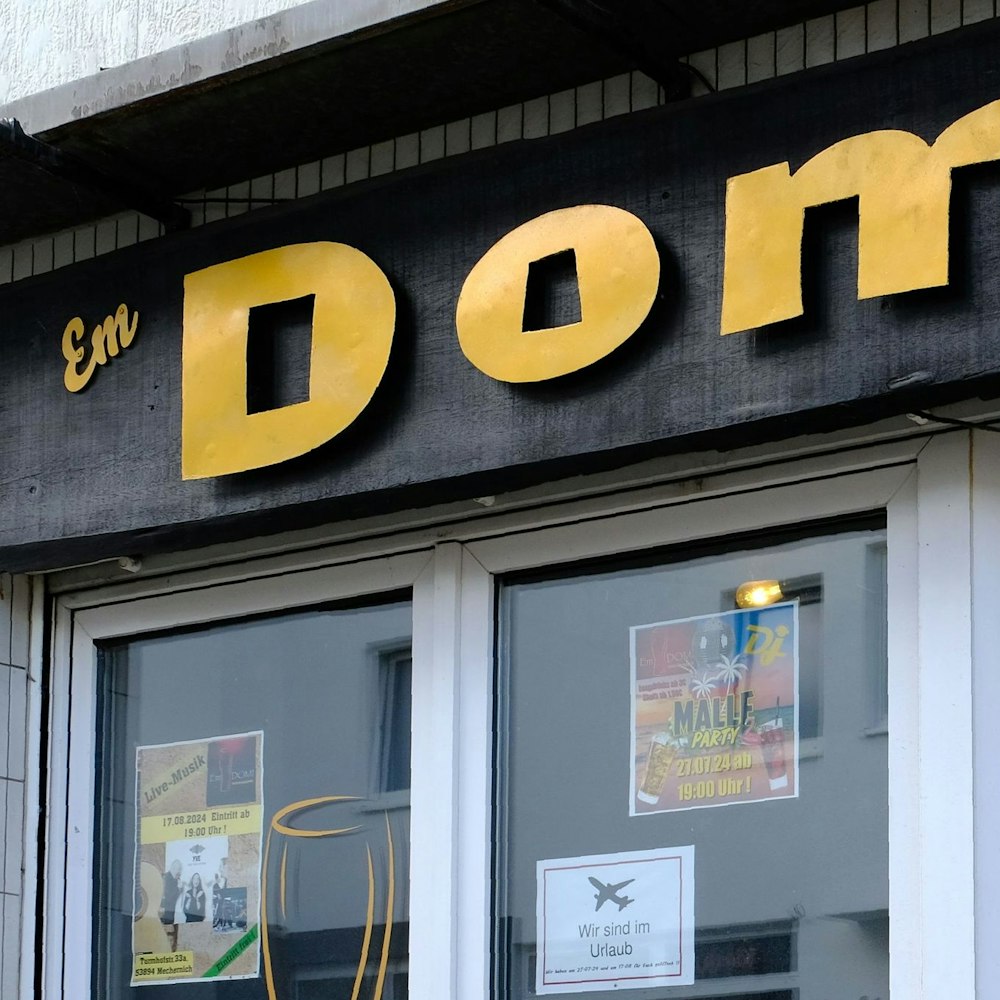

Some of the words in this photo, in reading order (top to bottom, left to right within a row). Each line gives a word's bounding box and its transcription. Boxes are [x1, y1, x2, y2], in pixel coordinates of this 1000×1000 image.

[61, 303, 139, 394] Em
[672, 690, 755, 736] MALLE
[691, 725, 740, 749] PARTY
[734, 752, 752, 771] ab
[144, 754, 206, 803] Live-Musik
[677, 781, 715, 802] 19:00
[719, 778, 744, 797] Uhr
[162, 813, 207, 827] 17.08.2024
[211, 810, 238, 821] Eintritt
[240, 809, 250, 819] ab
[184, 827, 206, 838] 19:00
[208, 825, 222, 836] Uhr
[578, 923, 600, 938] Wir
[603, 921, 630, 936] sind
[635, 920, 650, 934] im
[590, 941, 633, 958] Urlaub
[135, 967, 155, 977] 53894
[157, 965, 192, 975] Mechernich
